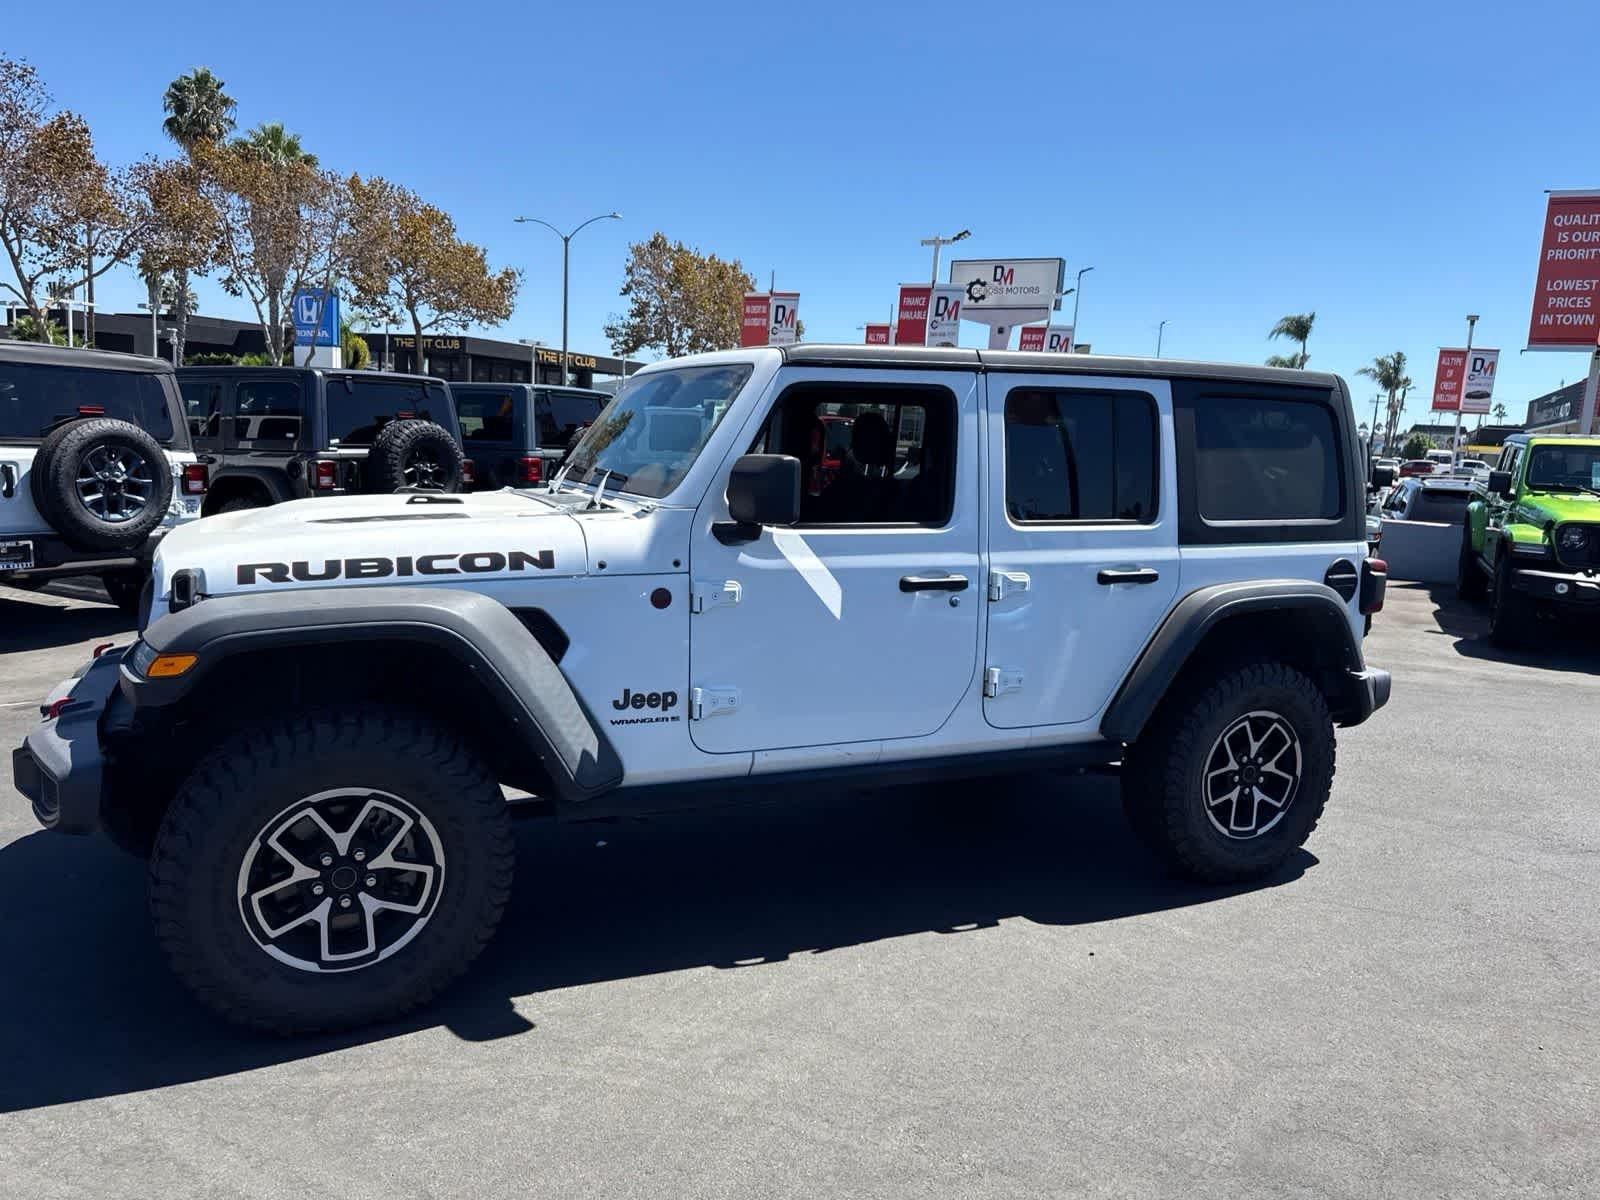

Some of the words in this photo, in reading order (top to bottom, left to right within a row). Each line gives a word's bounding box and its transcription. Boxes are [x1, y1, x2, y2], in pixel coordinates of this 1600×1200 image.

[1557, 232, 1569, 243] IS
[1571, 231, 1600, 243] OUR
[1005, 286, 1040, 295] MOTORS
[1546, 279, 1599, 291] LOWEST
[903, 297, 928, 306] FINANCE
[1547, 297, 1592, 308] PRICES
[1540, 314, 1554, 325] IN
[1556, 314, 1595, 325] TOWN
[393, 337, 415, 347] THE
[434, 338, 460, 350] CLUB
[536, 349, 557, 363] THE
[575, 355, 597, 369] CLUB
[236, 550, 555, 585] RUBICON
[612, 688, 678, 712] Jeep
[610, 715, 670, 725] WRANGLER
